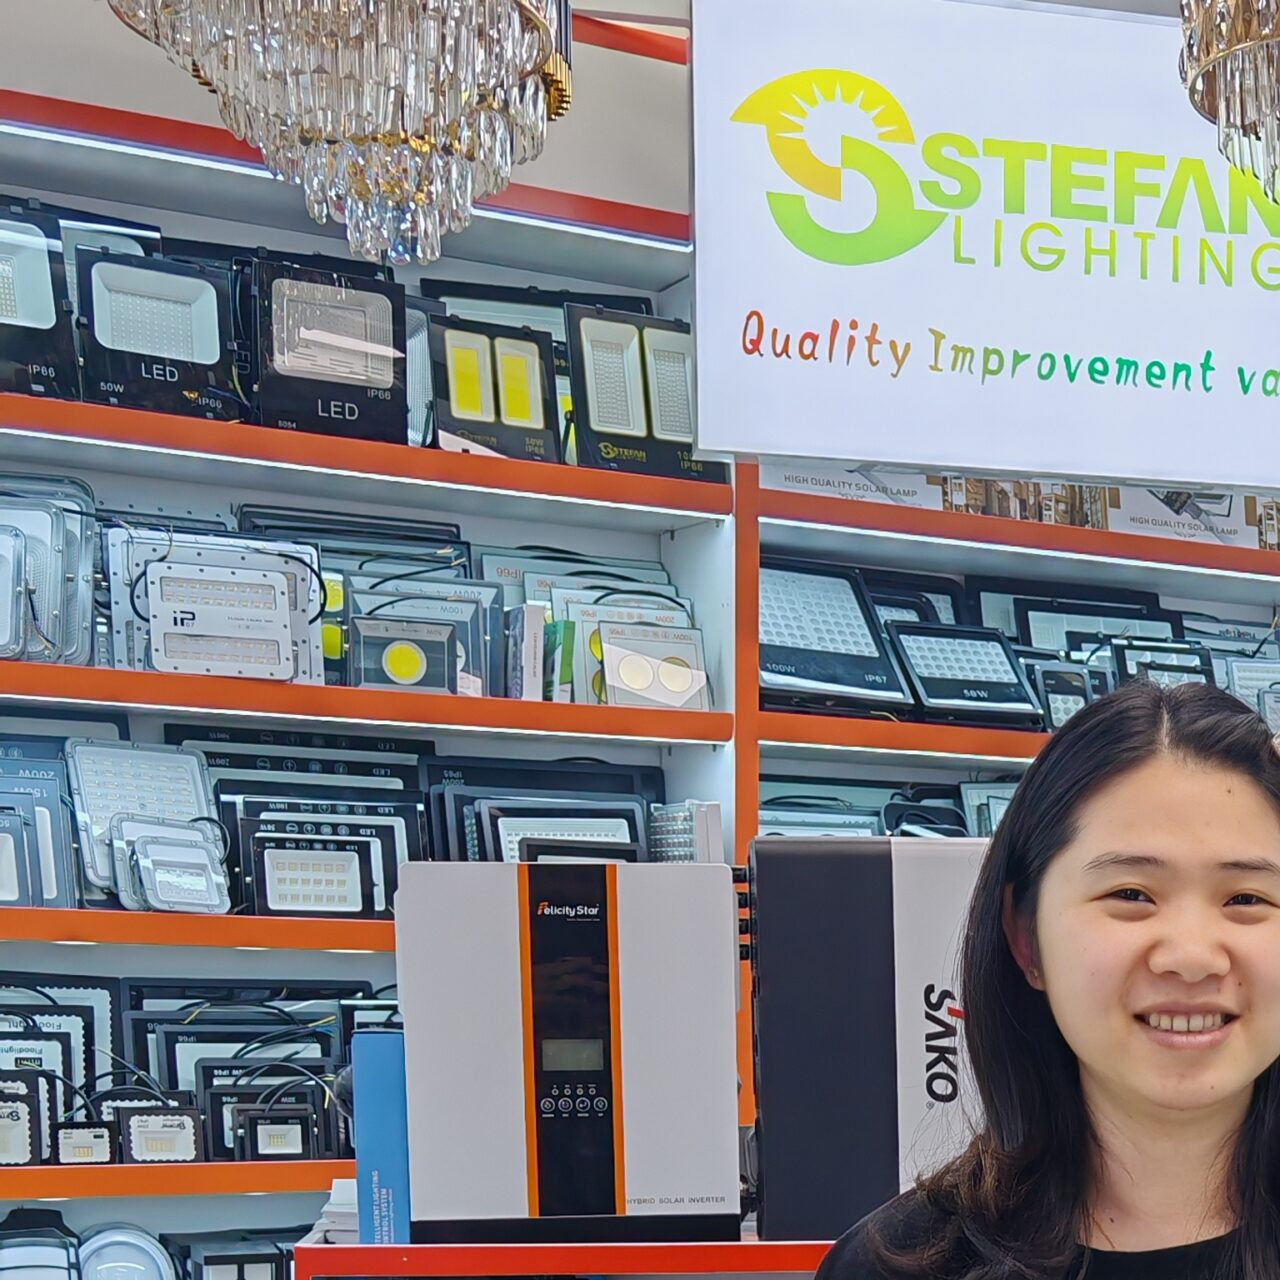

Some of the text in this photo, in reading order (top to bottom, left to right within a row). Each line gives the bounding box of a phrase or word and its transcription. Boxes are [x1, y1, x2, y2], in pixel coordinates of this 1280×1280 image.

[740, 308, 912, 379] Quality
[926, 327, 1214, 394] Improvement
[28, 363, 56, 378] IP66
[141, 362, 179, 383] LED
[100, 381, 125, 393] 50W
[367, 388, 391, 400] IP66
[317, 398, 359, 421] LED
[783, 473, 918, 498] HIGH QUALITY SOLAR LAMP
[1129, 515, 1239, 536] HIGH QUALITY SOLAR LAMP
[577, 903, 600, 916] Star
[923, 982, 966, 1104] SAKO
[627, 1195, 726, 1205] HYBRID SOLAR INVERTER
